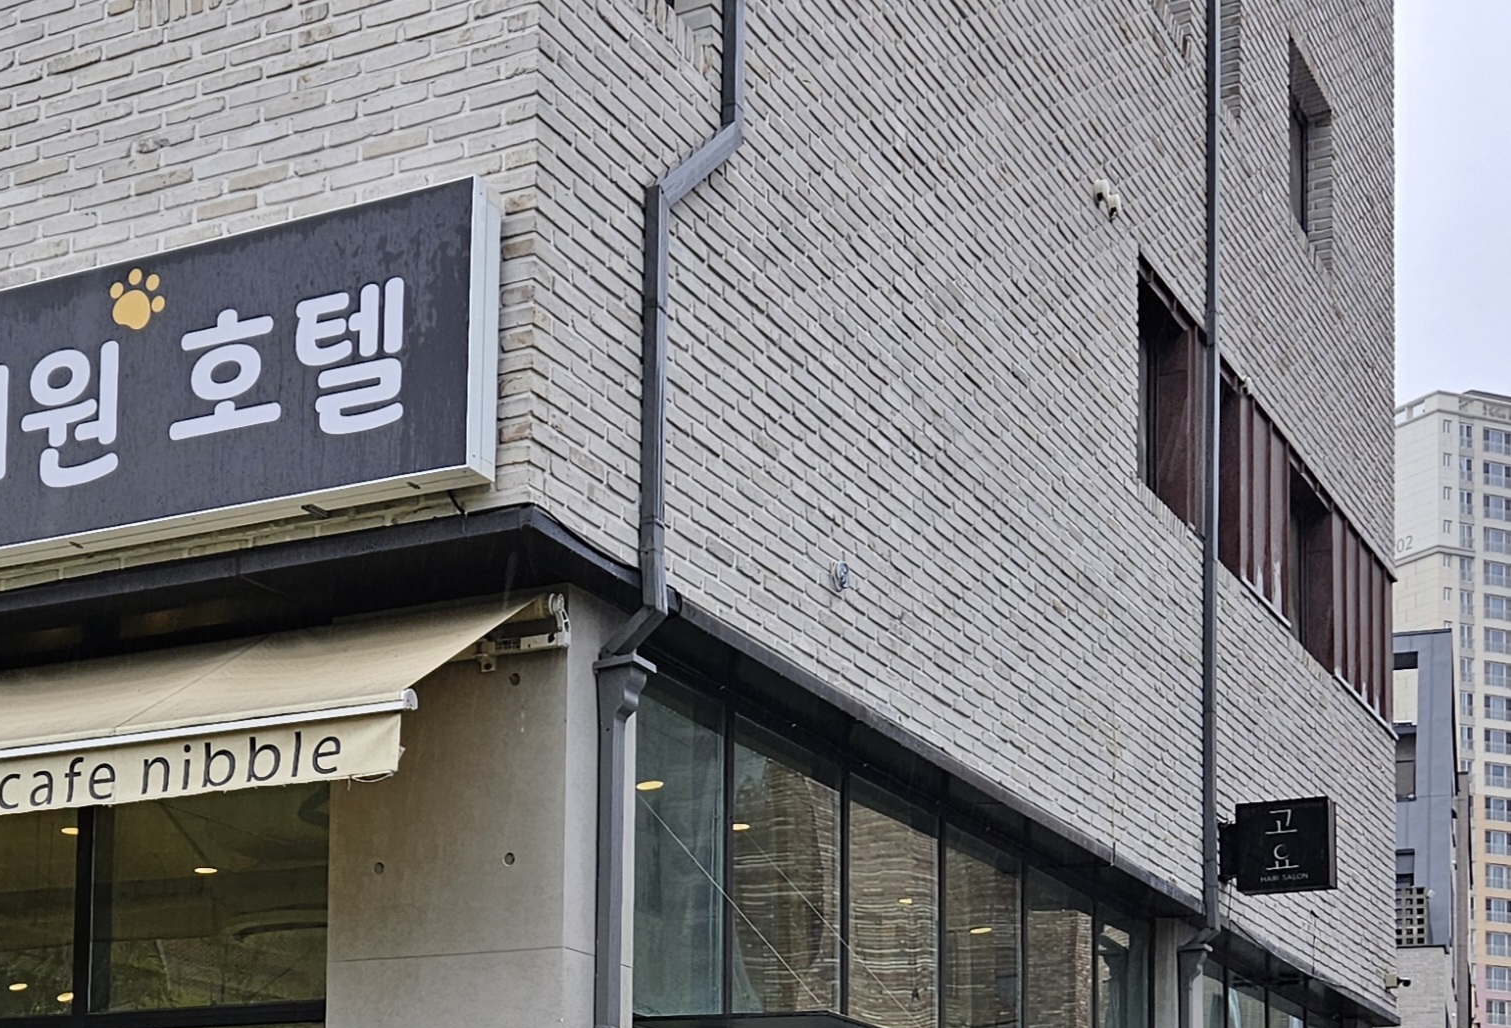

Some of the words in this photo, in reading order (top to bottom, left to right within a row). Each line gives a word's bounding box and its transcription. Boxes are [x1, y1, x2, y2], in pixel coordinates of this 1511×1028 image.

[169, 276, 405, 442] 호텔
[141, 730, 341, 795] nibble
[1265, 808, 1300, 870] 고요
[1281, 872, 1309, 880] SALON
